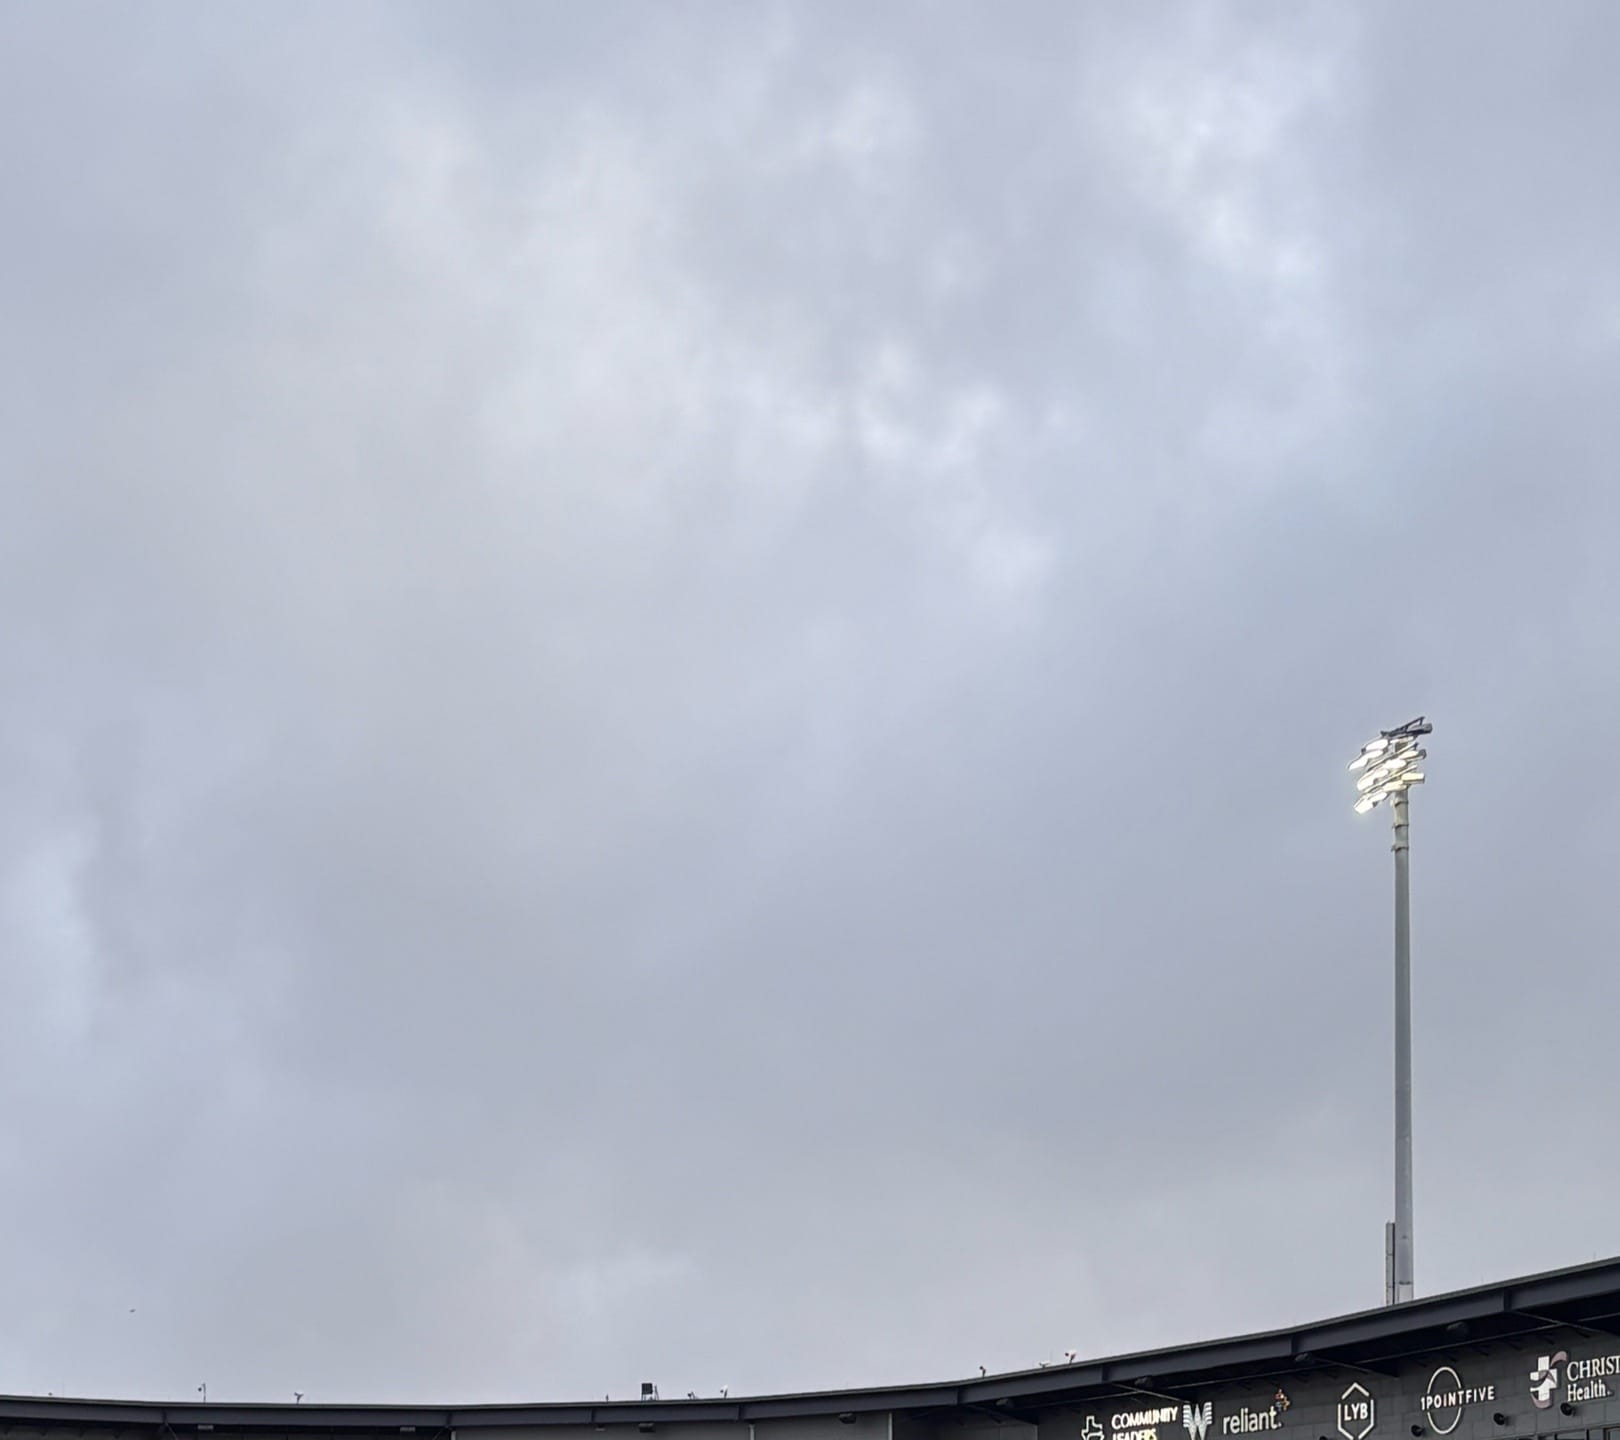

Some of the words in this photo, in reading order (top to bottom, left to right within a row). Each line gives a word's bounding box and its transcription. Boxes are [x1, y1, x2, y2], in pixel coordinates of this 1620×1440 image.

[1421, 1385, 1495, 1411] 1POINTFIVE
[1111, 1406, 1178, 1430] COMMUNITY
[1344, 1402, 1368, 1422] LYB
